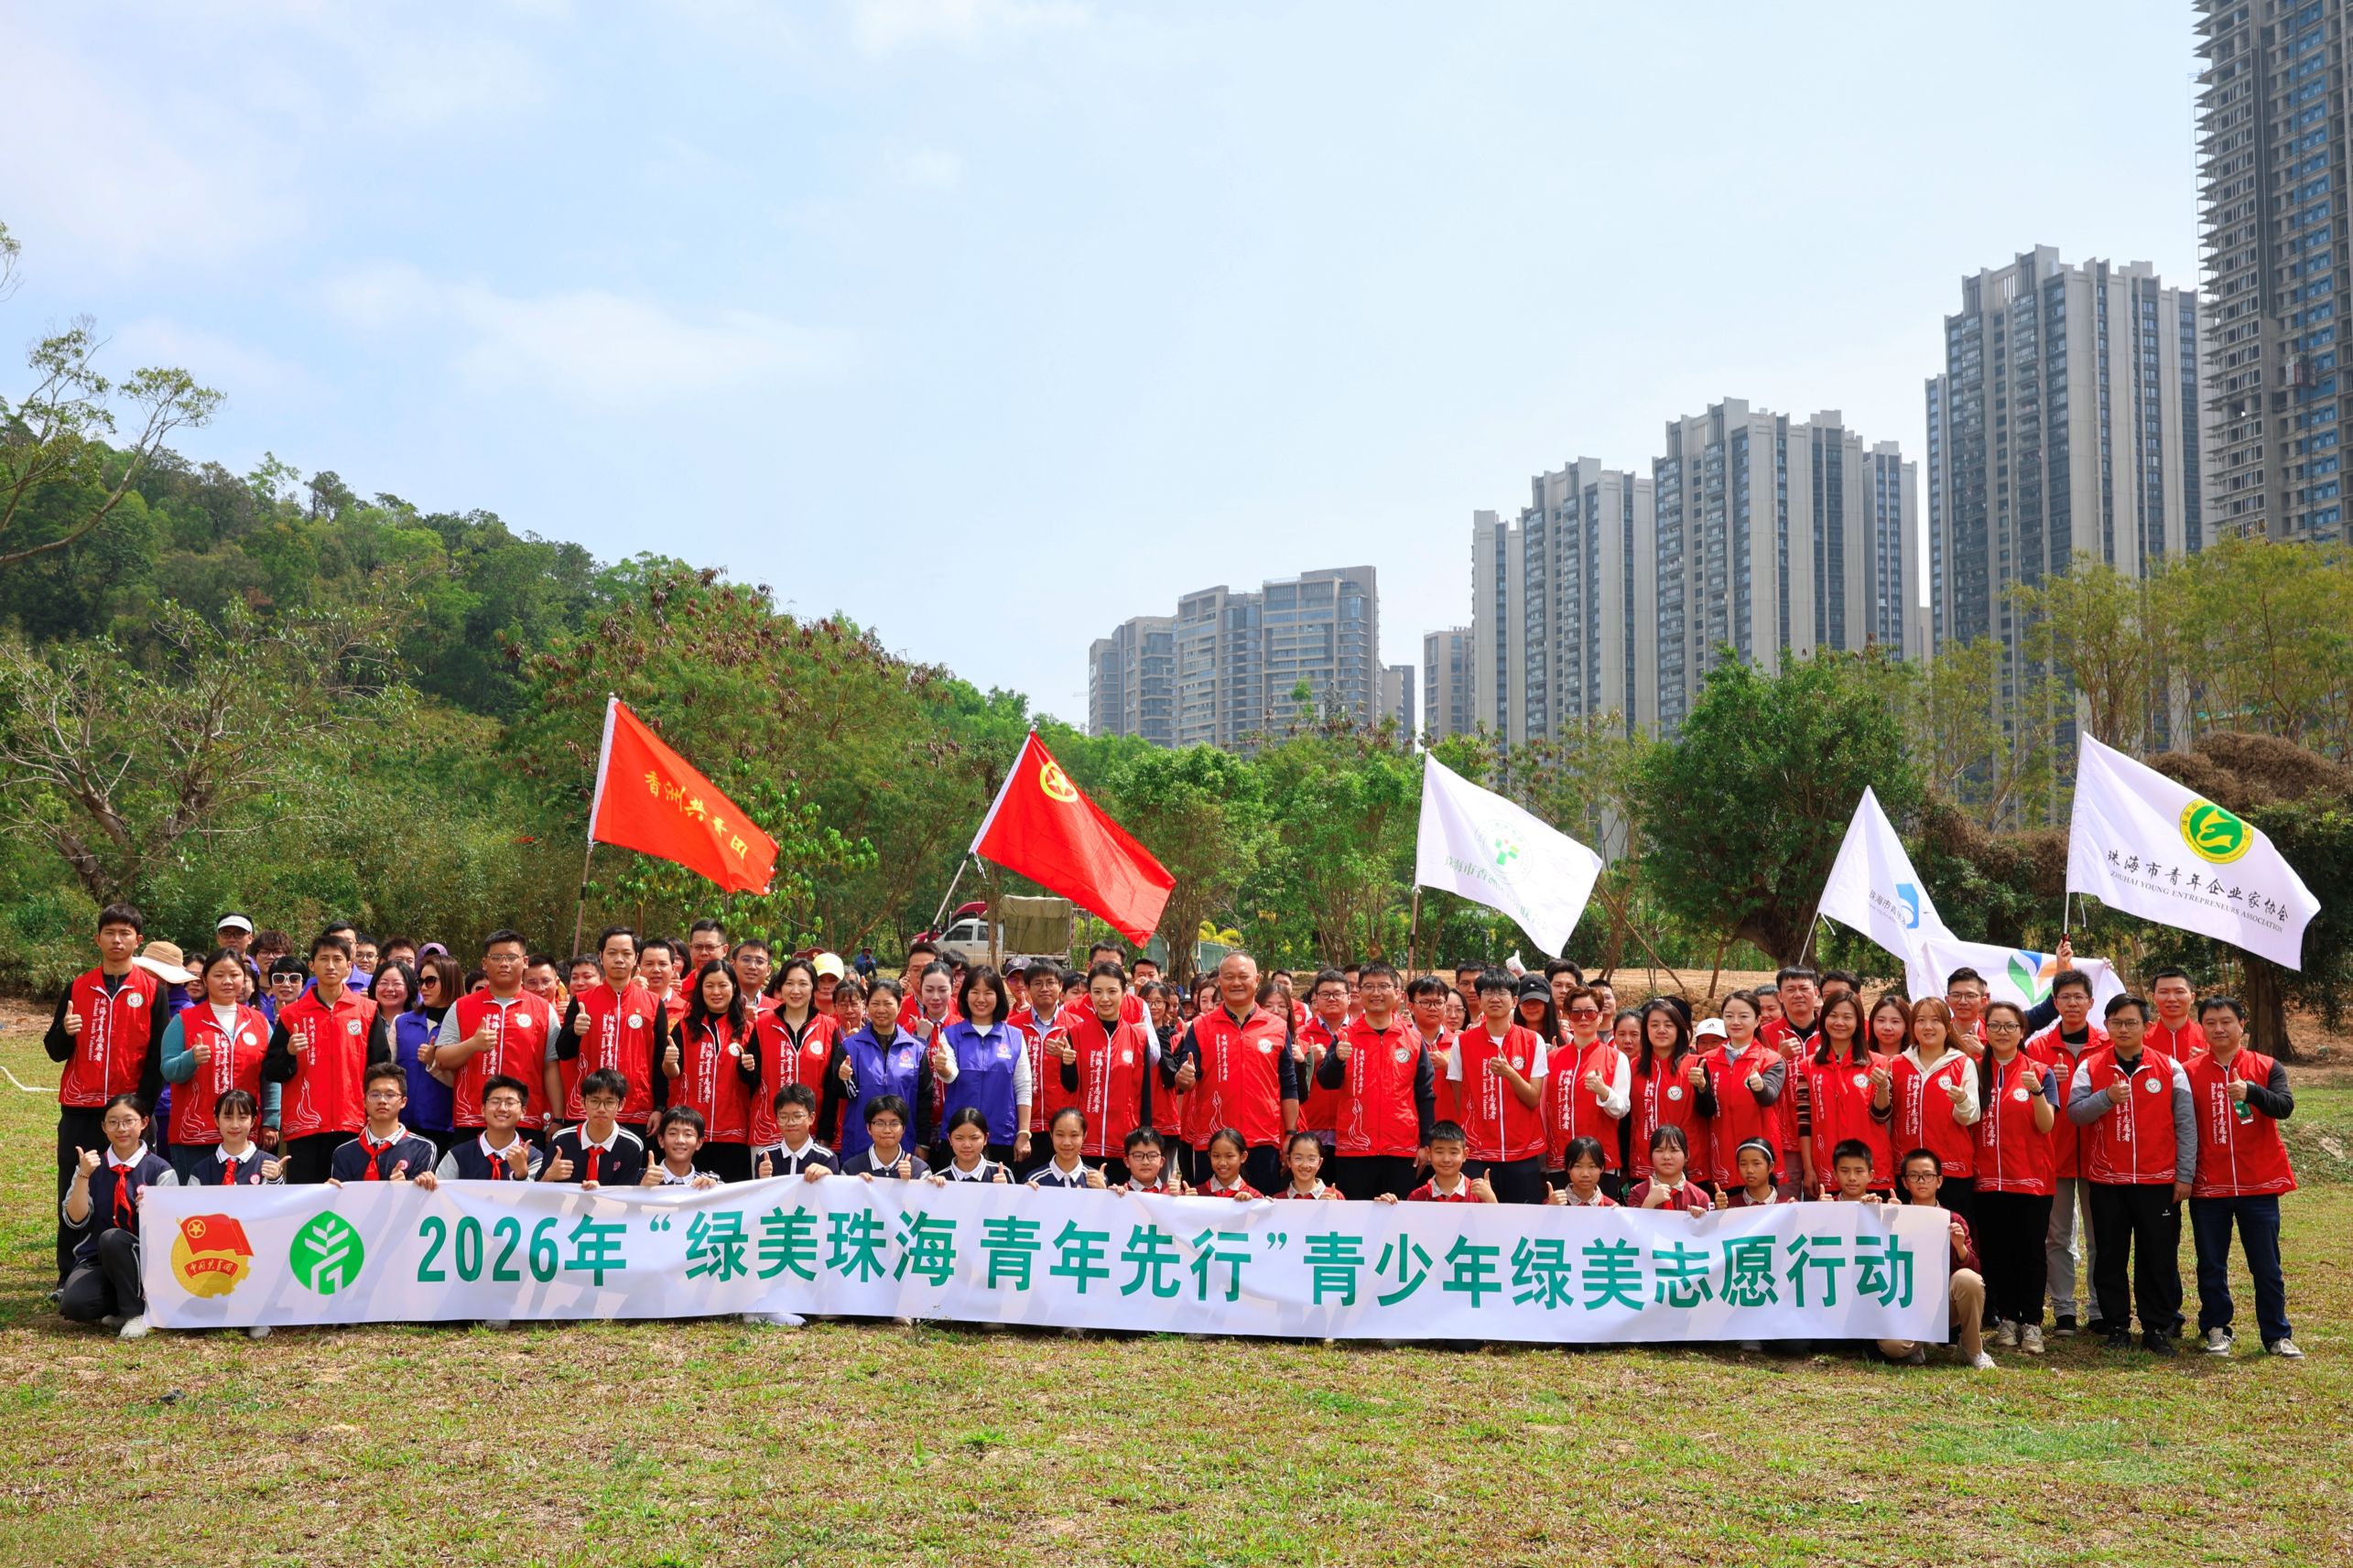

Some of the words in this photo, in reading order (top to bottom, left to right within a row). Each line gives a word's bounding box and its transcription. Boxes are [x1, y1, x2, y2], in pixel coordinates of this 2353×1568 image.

[2108, 849, 2290, 923] 珠海市青年企业家协会
[2110, 871, 2139, 886] ZHUHAI
[2141, 880, 2169, 895] YOUNG
[2172, 889, 2239, 916] ENTREPRENEURS
[2241, 911, 2283, 934] ASSOCIATION
